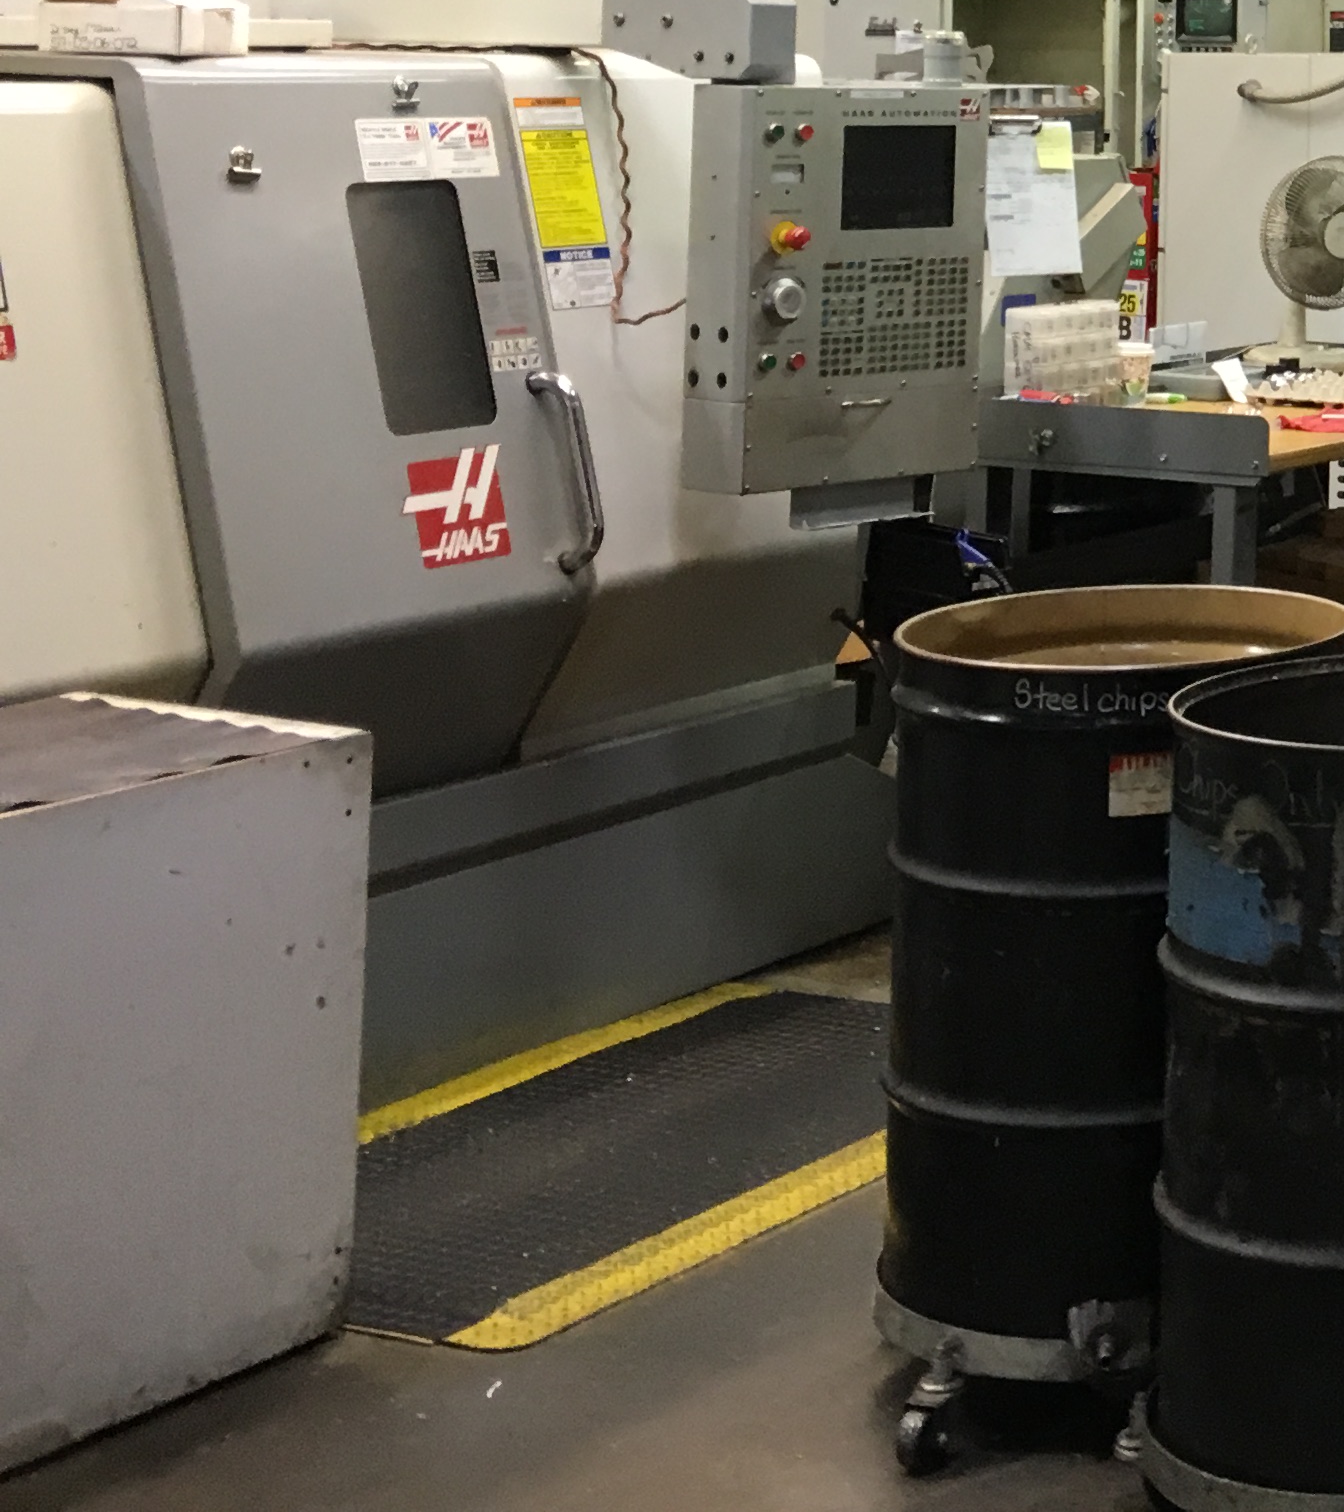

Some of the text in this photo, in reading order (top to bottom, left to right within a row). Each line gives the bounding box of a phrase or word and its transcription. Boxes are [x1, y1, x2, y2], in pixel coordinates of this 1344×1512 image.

[559, 249, 594, 260] NOTICE
[421, 522, 508, 562] HAAS
[1014, 678, 1169, 717] Steel chips
